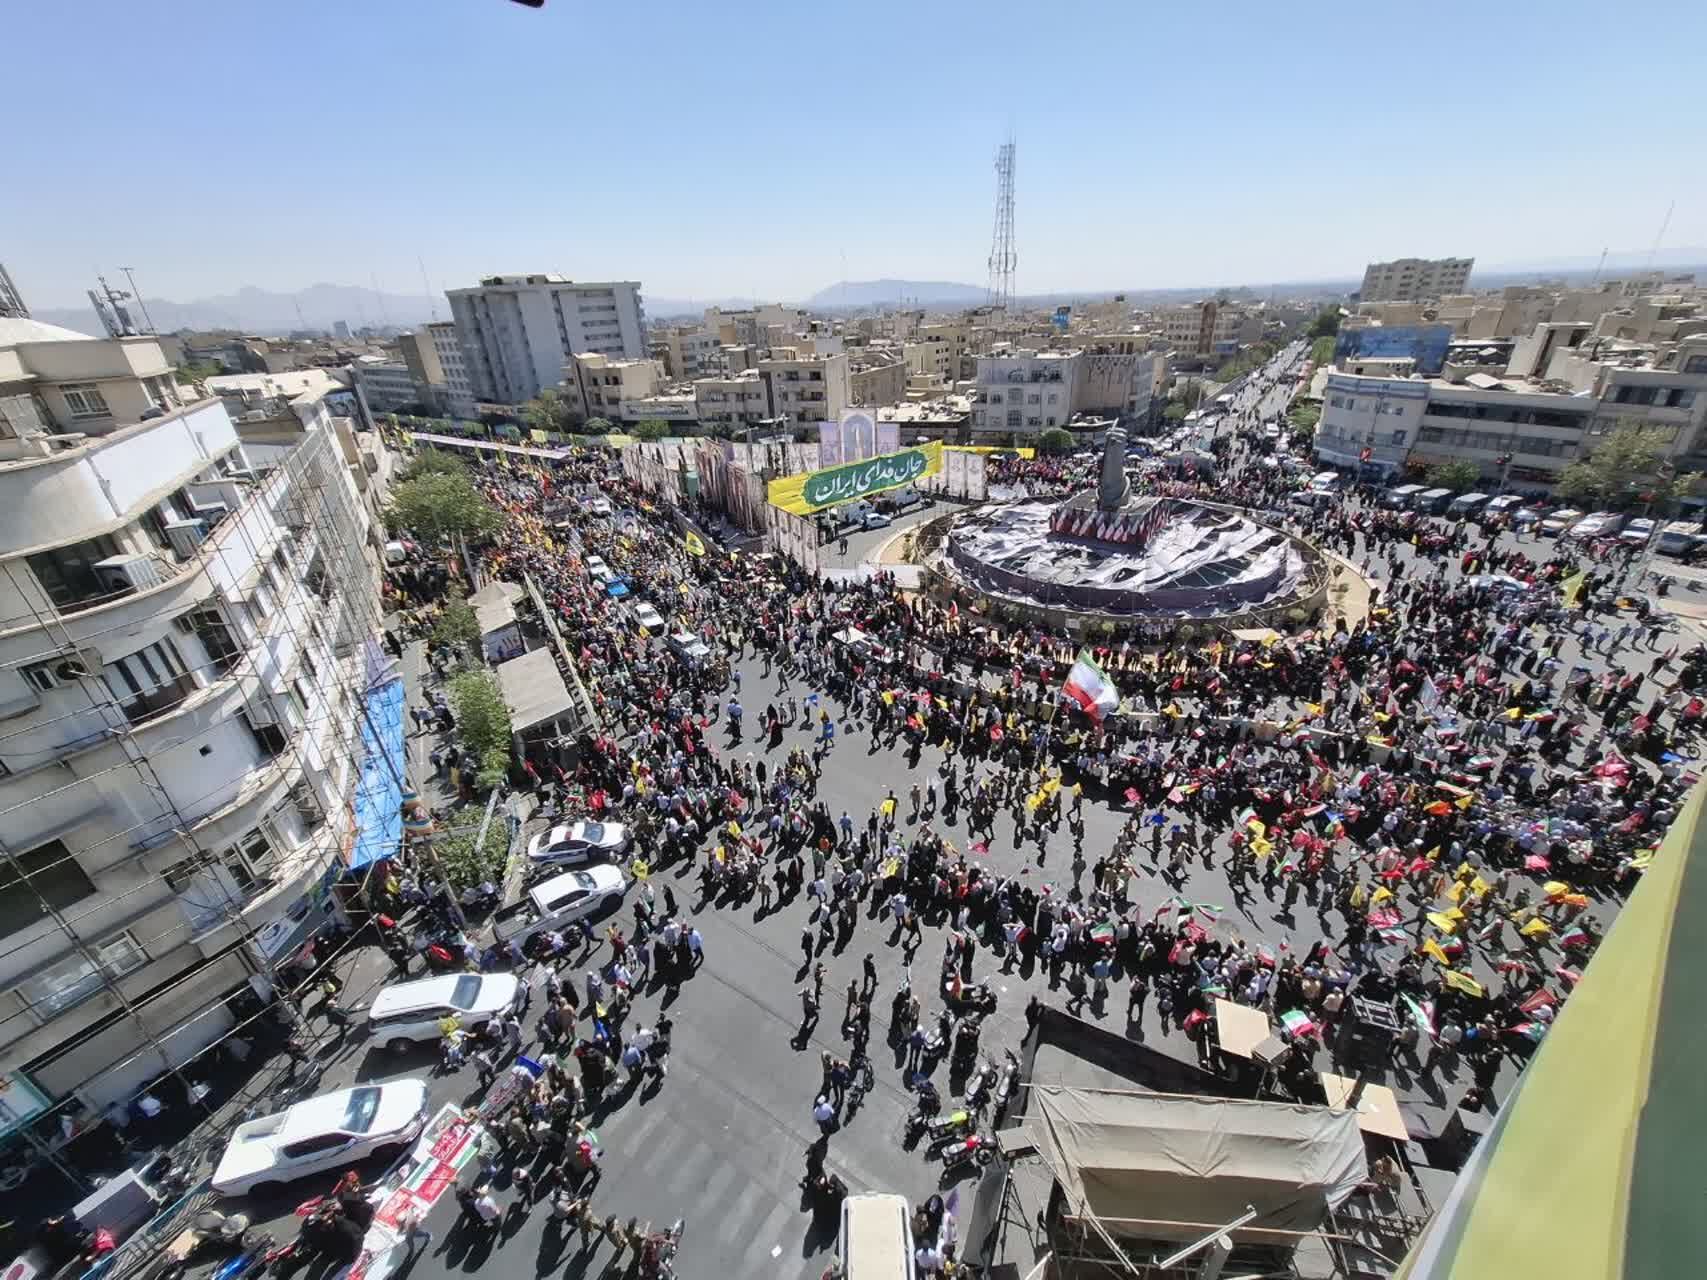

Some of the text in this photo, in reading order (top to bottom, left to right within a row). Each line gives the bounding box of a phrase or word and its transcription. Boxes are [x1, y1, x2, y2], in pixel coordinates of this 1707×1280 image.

[815, 456, 922, 502] جان فدای ایران
